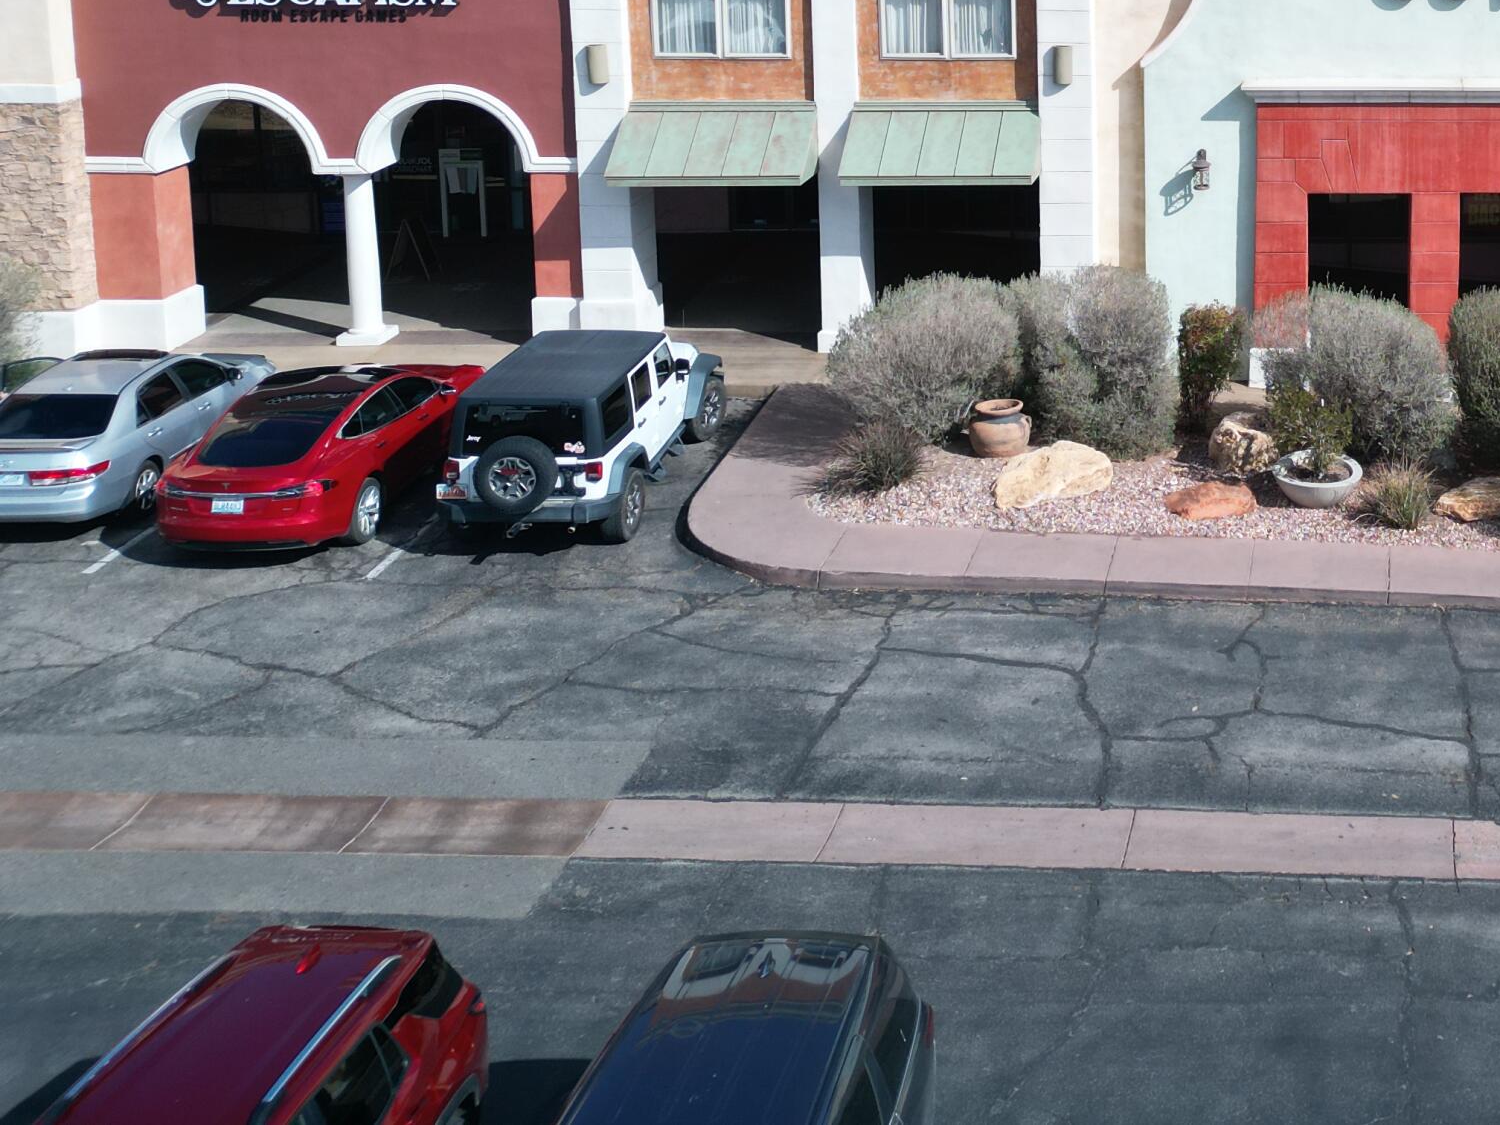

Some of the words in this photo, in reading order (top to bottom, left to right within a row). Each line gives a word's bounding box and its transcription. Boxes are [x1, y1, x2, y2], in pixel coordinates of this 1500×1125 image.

[239, 9, 283, 23] ROOM
[289, 9, 348, 23] ESCAPE
[355, 9, 407, 23] GAMES
